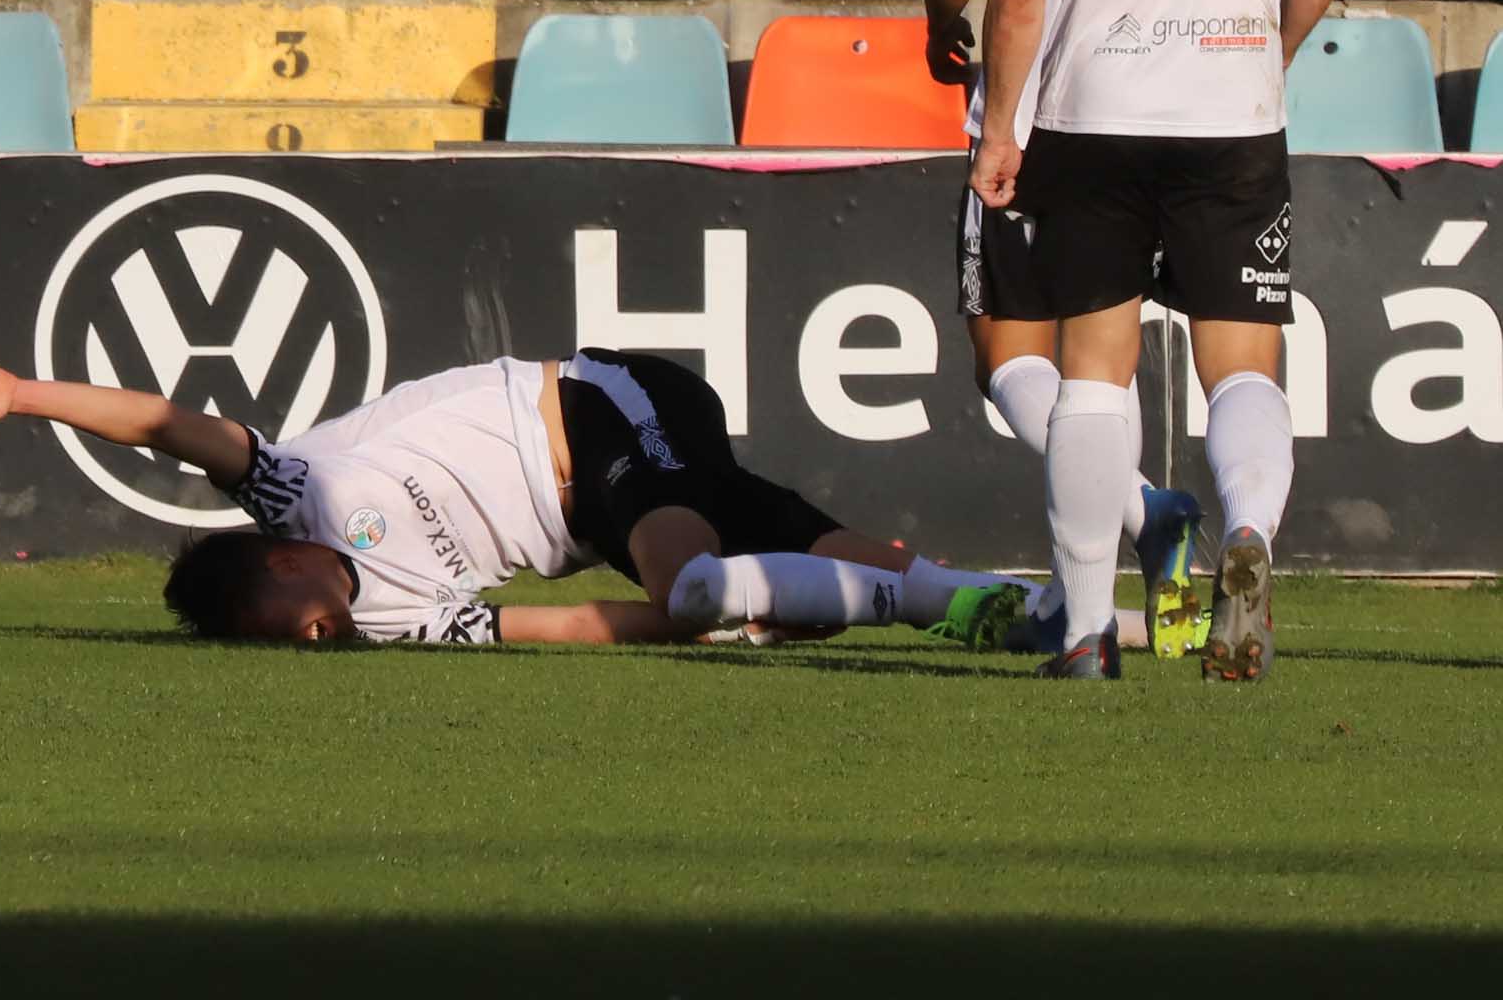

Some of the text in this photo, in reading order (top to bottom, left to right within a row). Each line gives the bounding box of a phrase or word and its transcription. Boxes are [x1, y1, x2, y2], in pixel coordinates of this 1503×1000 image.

[1152, 12, 1266, 46] gruponani
[273, 31, 308, 79] 3
[1241, 266, 1290, 284] Domin
